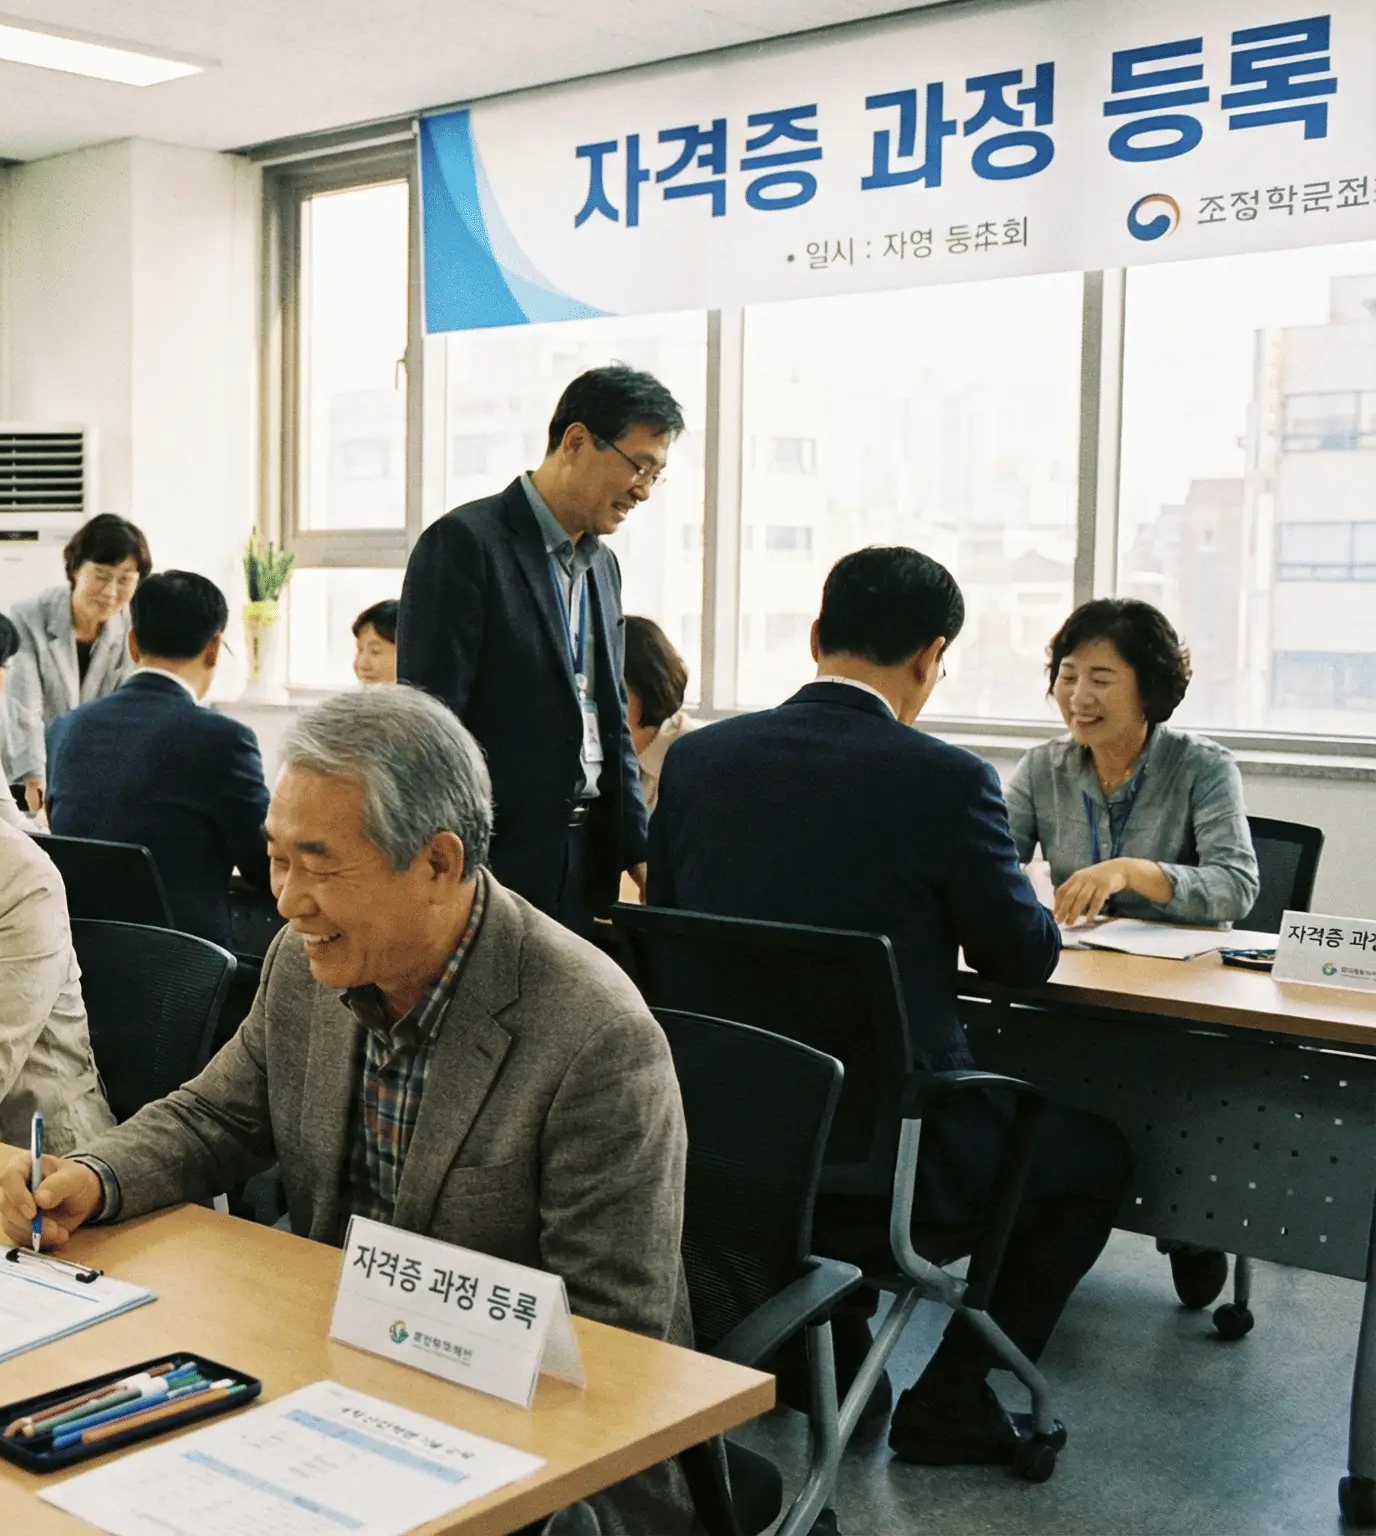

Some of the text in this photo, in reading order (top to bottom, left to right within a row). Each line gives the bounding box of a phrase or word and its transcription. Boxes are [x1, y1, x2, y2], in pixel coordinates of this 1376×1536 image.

[574, 14, 1338, 229] 자격증 과정 등록
[806, 237, 854, 270] 일시
[1287, 925, 1345, 949] 자격증
[353, 1244, 538, 1330] 자격증 과정 등록
